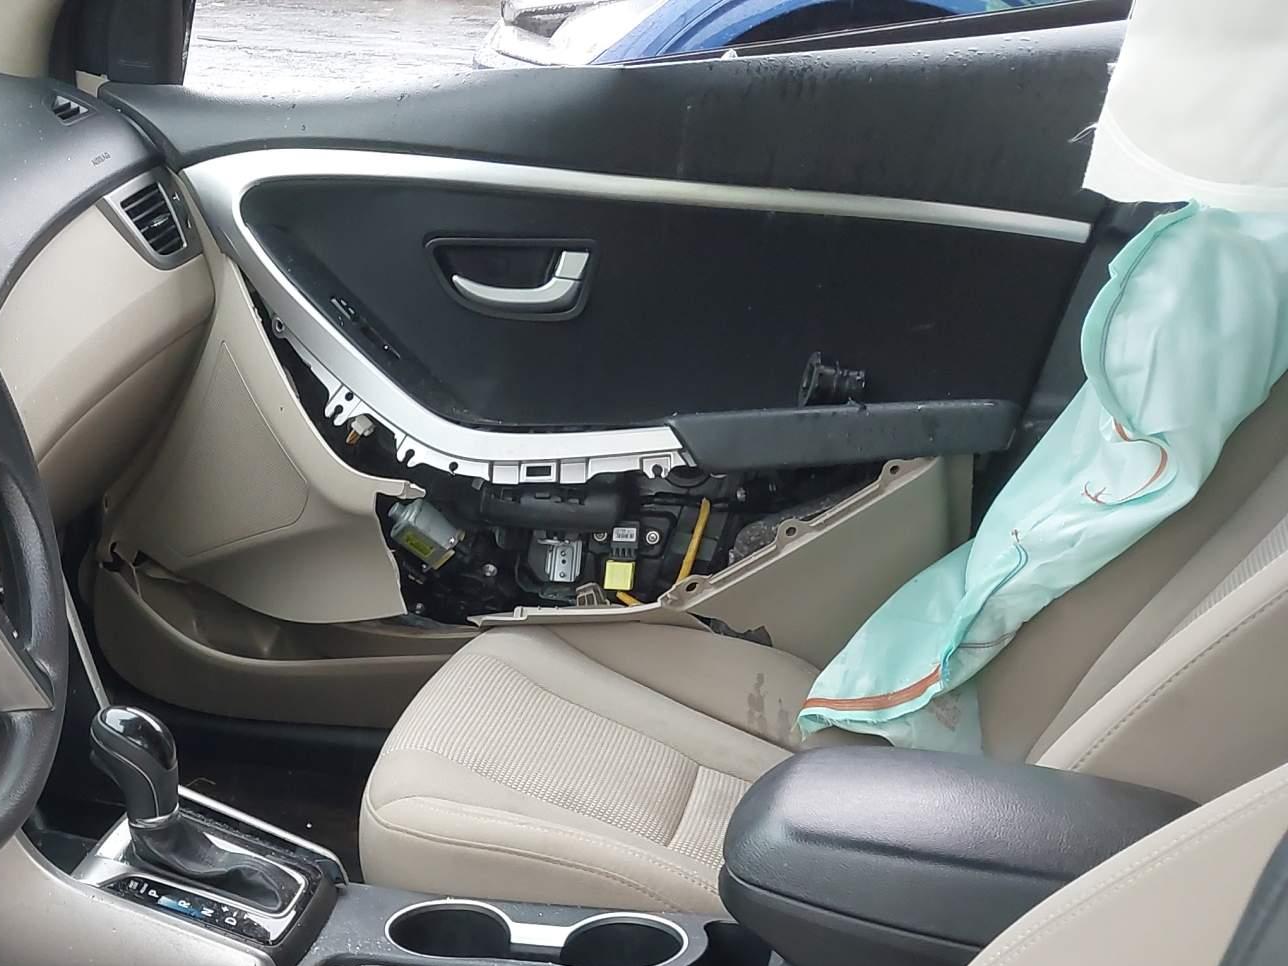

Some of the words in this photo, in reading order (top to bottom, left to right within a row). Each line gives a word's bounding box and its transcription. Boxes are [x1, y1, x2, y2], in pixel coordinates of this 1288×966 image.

[148, 888, 160, 899] P
[177, 899, 192, 909] R
[201, 907, 216, 917] N
[224, 916, 238, 926] D
